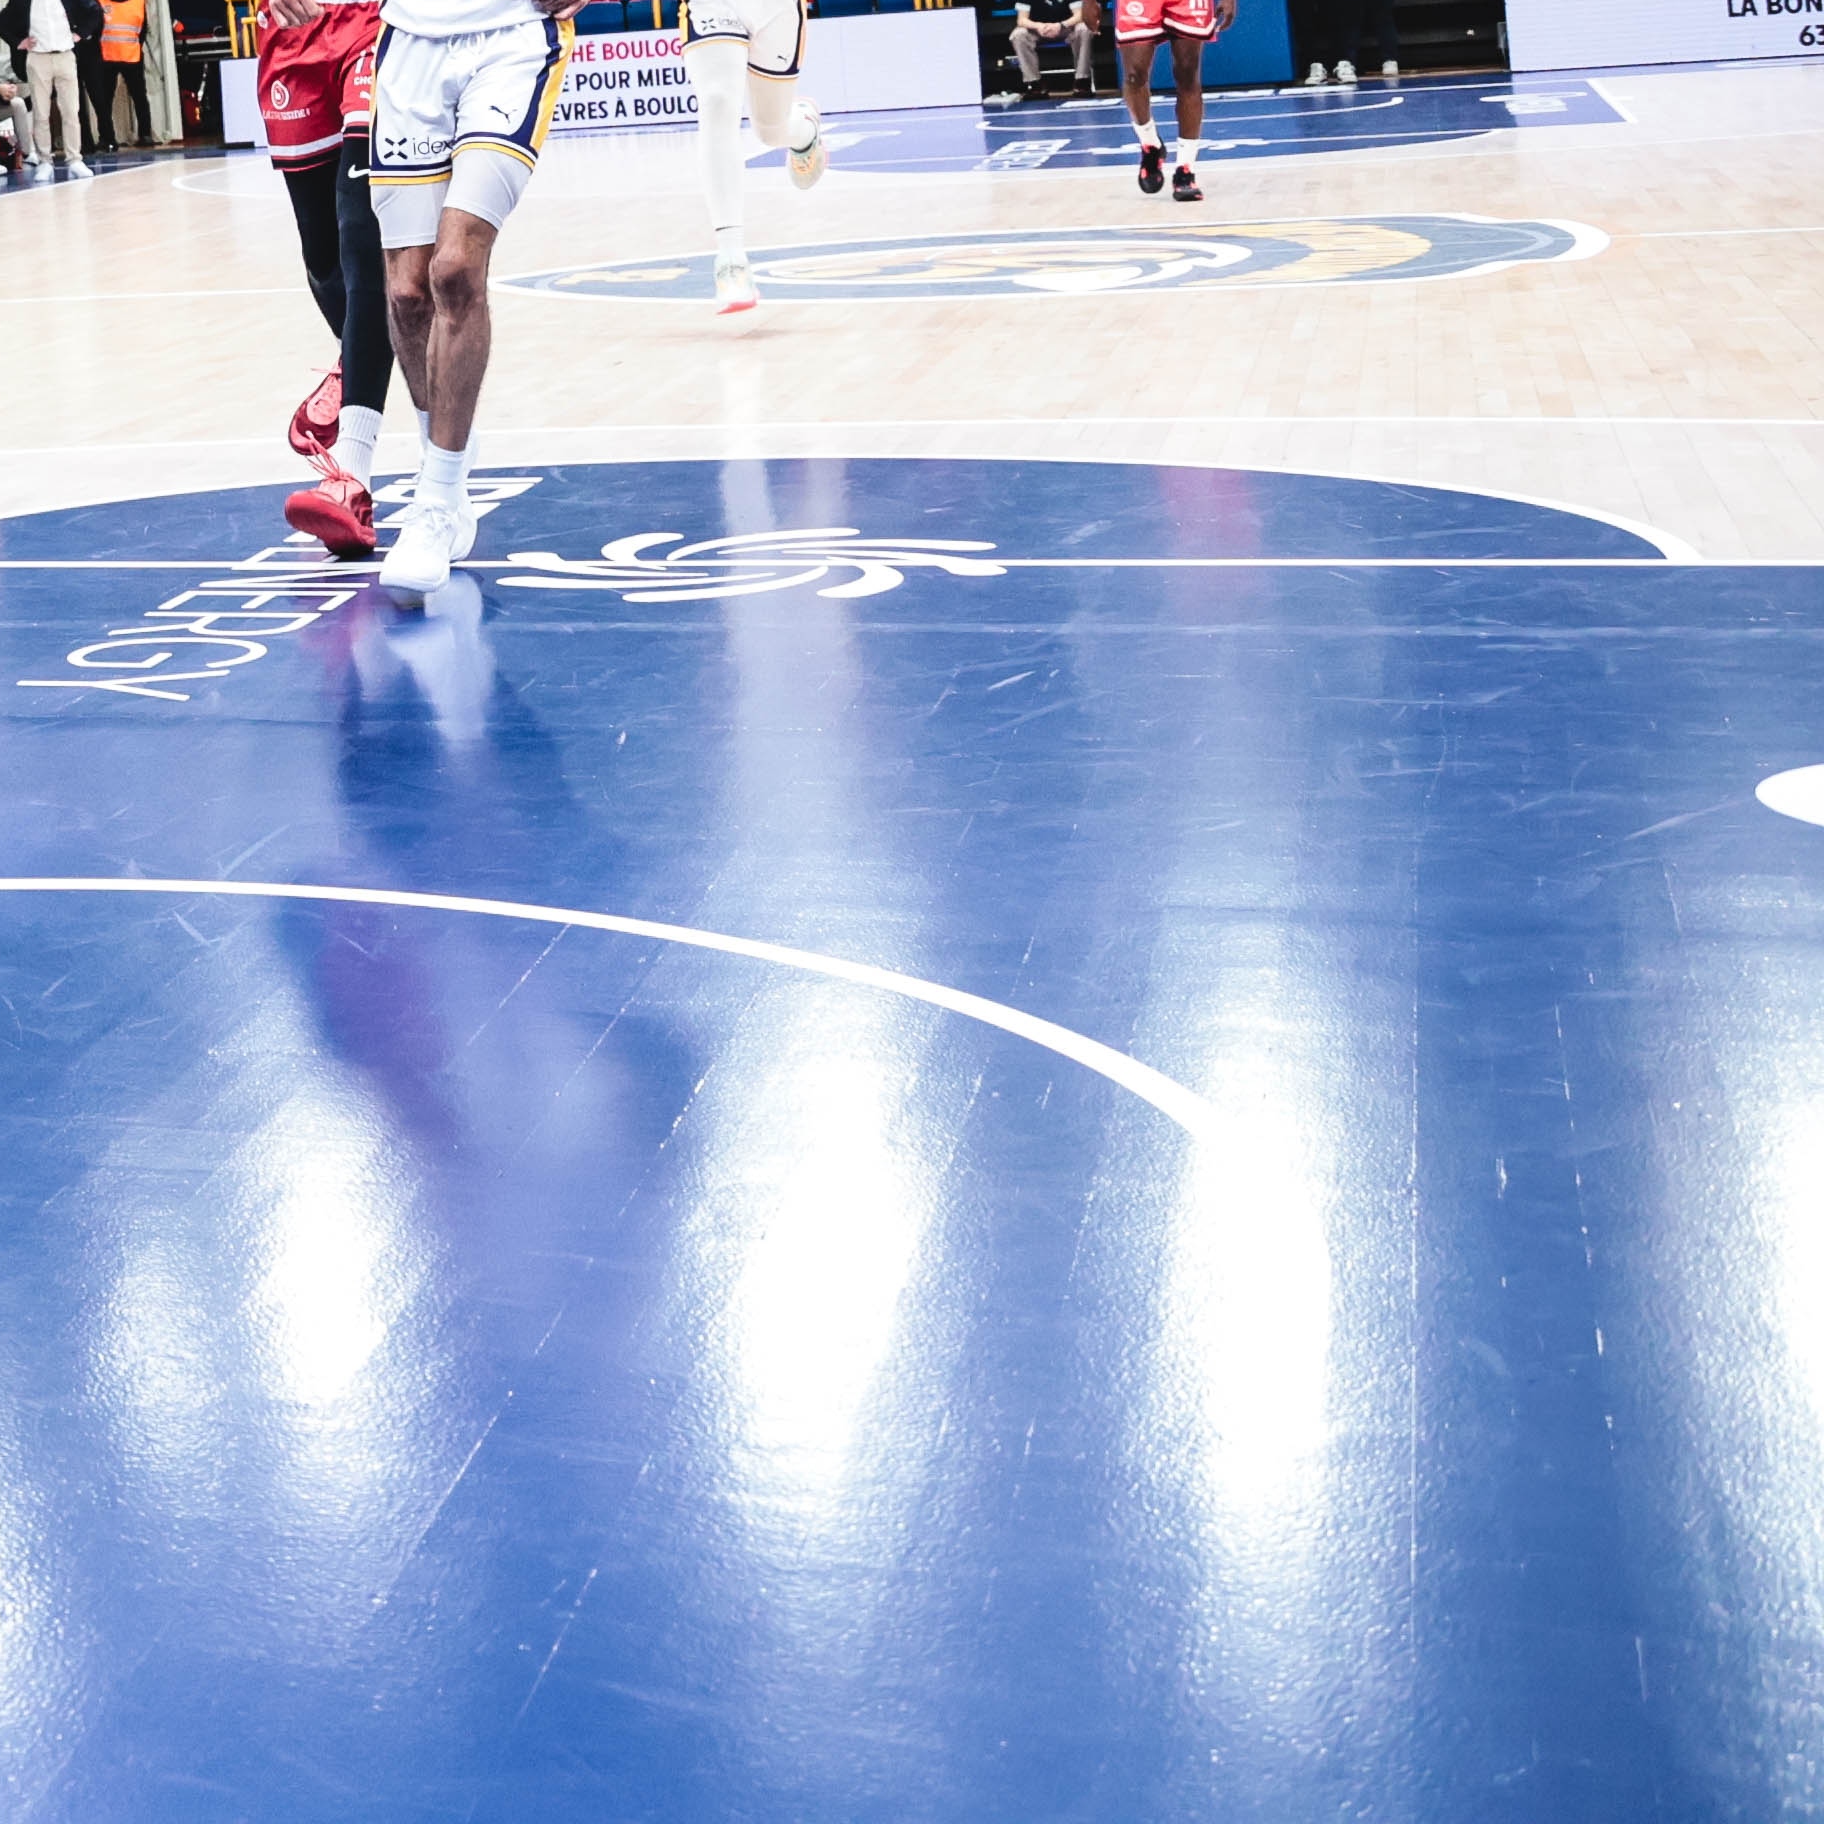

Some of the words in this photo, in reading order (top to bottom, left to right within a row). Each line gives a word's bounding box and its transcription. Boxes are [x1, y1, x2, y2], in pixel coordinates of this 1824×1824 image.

[575, 70, 631, 93] POUR
[637, 67, 692, 88] MIEU
[614, 96, 628, 119] À
